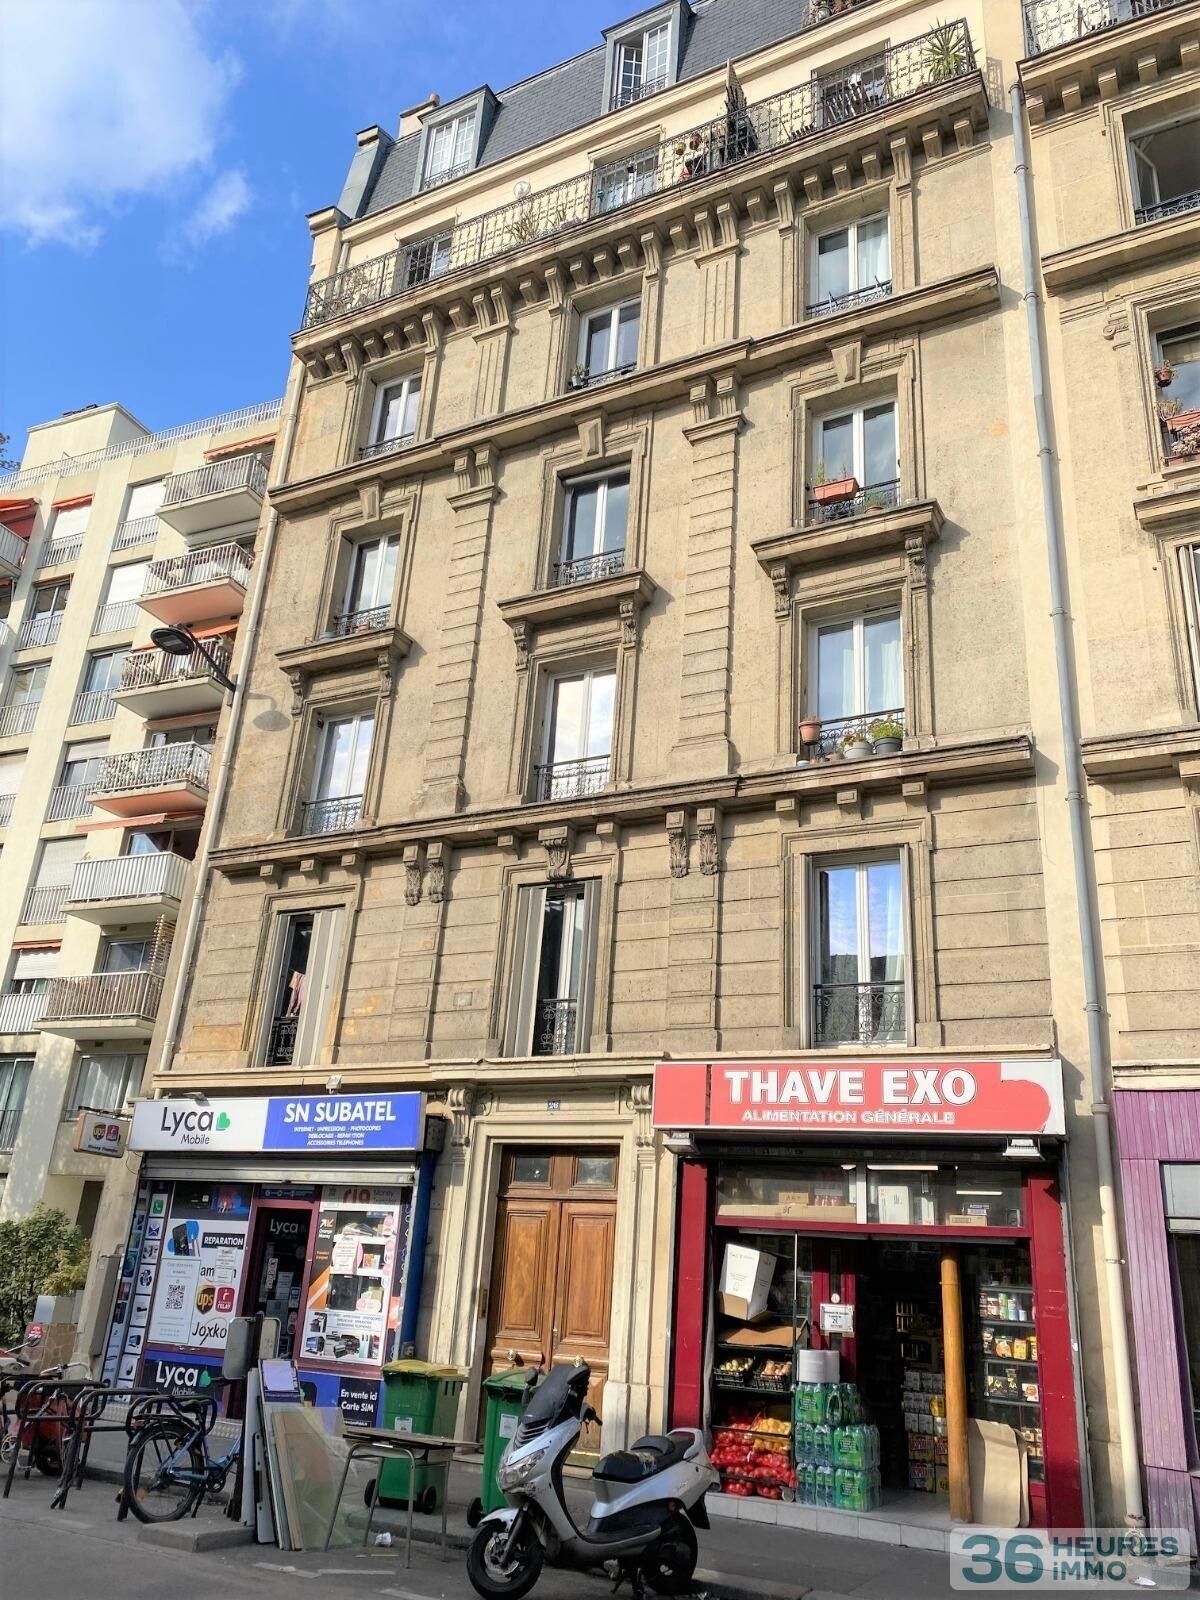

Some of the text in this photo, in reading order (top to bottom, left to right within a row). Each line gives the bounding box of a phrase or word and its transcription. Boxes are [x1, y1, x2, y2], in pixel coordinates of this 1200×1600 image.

[724, 1068, 976, 1106] THAVE EXO
[284, 1101, 396, 1123] SN SUBATEL
[741, 1108, 955, 1125] ALIMENTATION GÉNÉRALE
[161, 1107, 214, 1136] Lyca
[181, 1134, 210, 1144] Mobile
[270, 1219, 299, 1235] Lyca
[204, 1236, 244, 1246] REPARATION
[197, 1293, 214, 1310] ups
[156, 1361, 199, 1388] Lyca
[172, 1386, 196, 1396] Mobile
[340, 1388, 378, 1401] En vente ici
[341, 1401, 360, 1411] Carte
